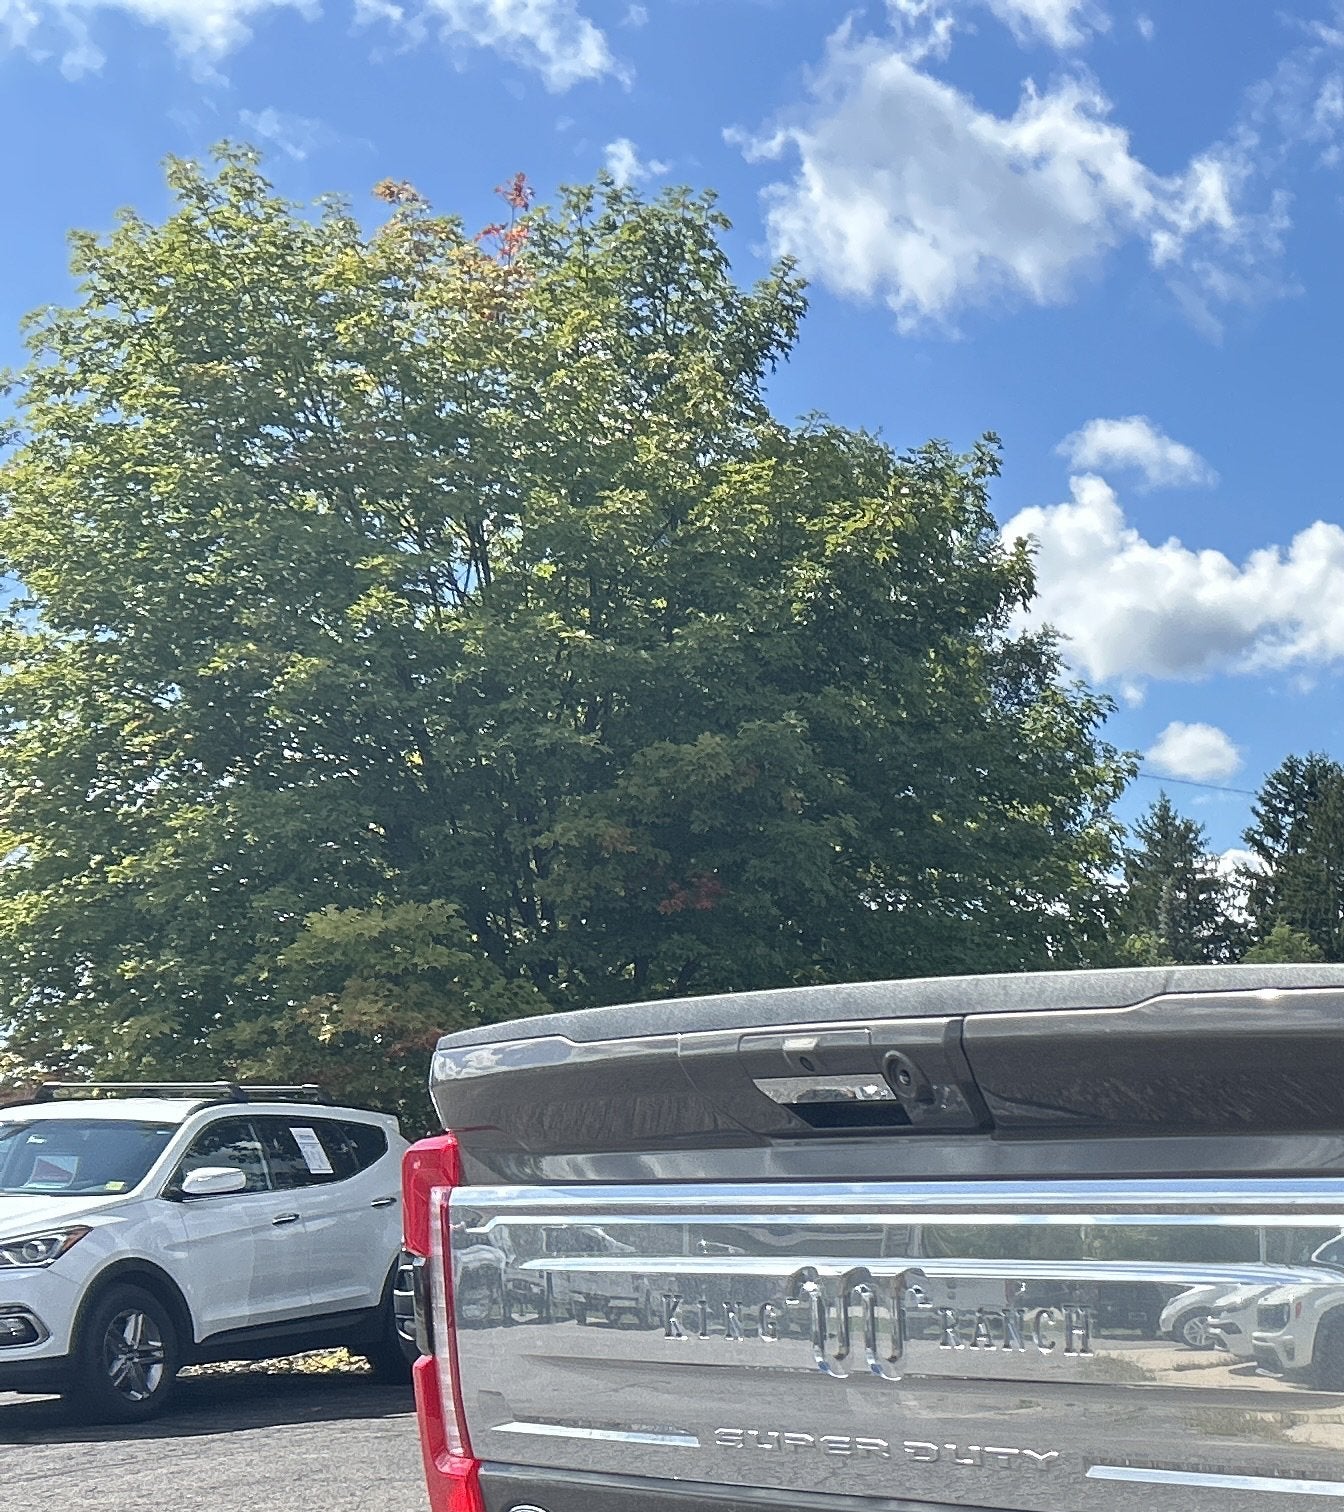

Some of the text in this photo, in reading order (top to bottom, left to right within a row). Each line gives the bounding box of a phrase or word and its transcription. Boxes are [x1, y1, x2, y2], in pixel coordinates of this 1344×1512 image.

[662, 1294, 1096, 1358] KING RANCH
[713, 1426, 1061, 1466] SUPER DUTY
